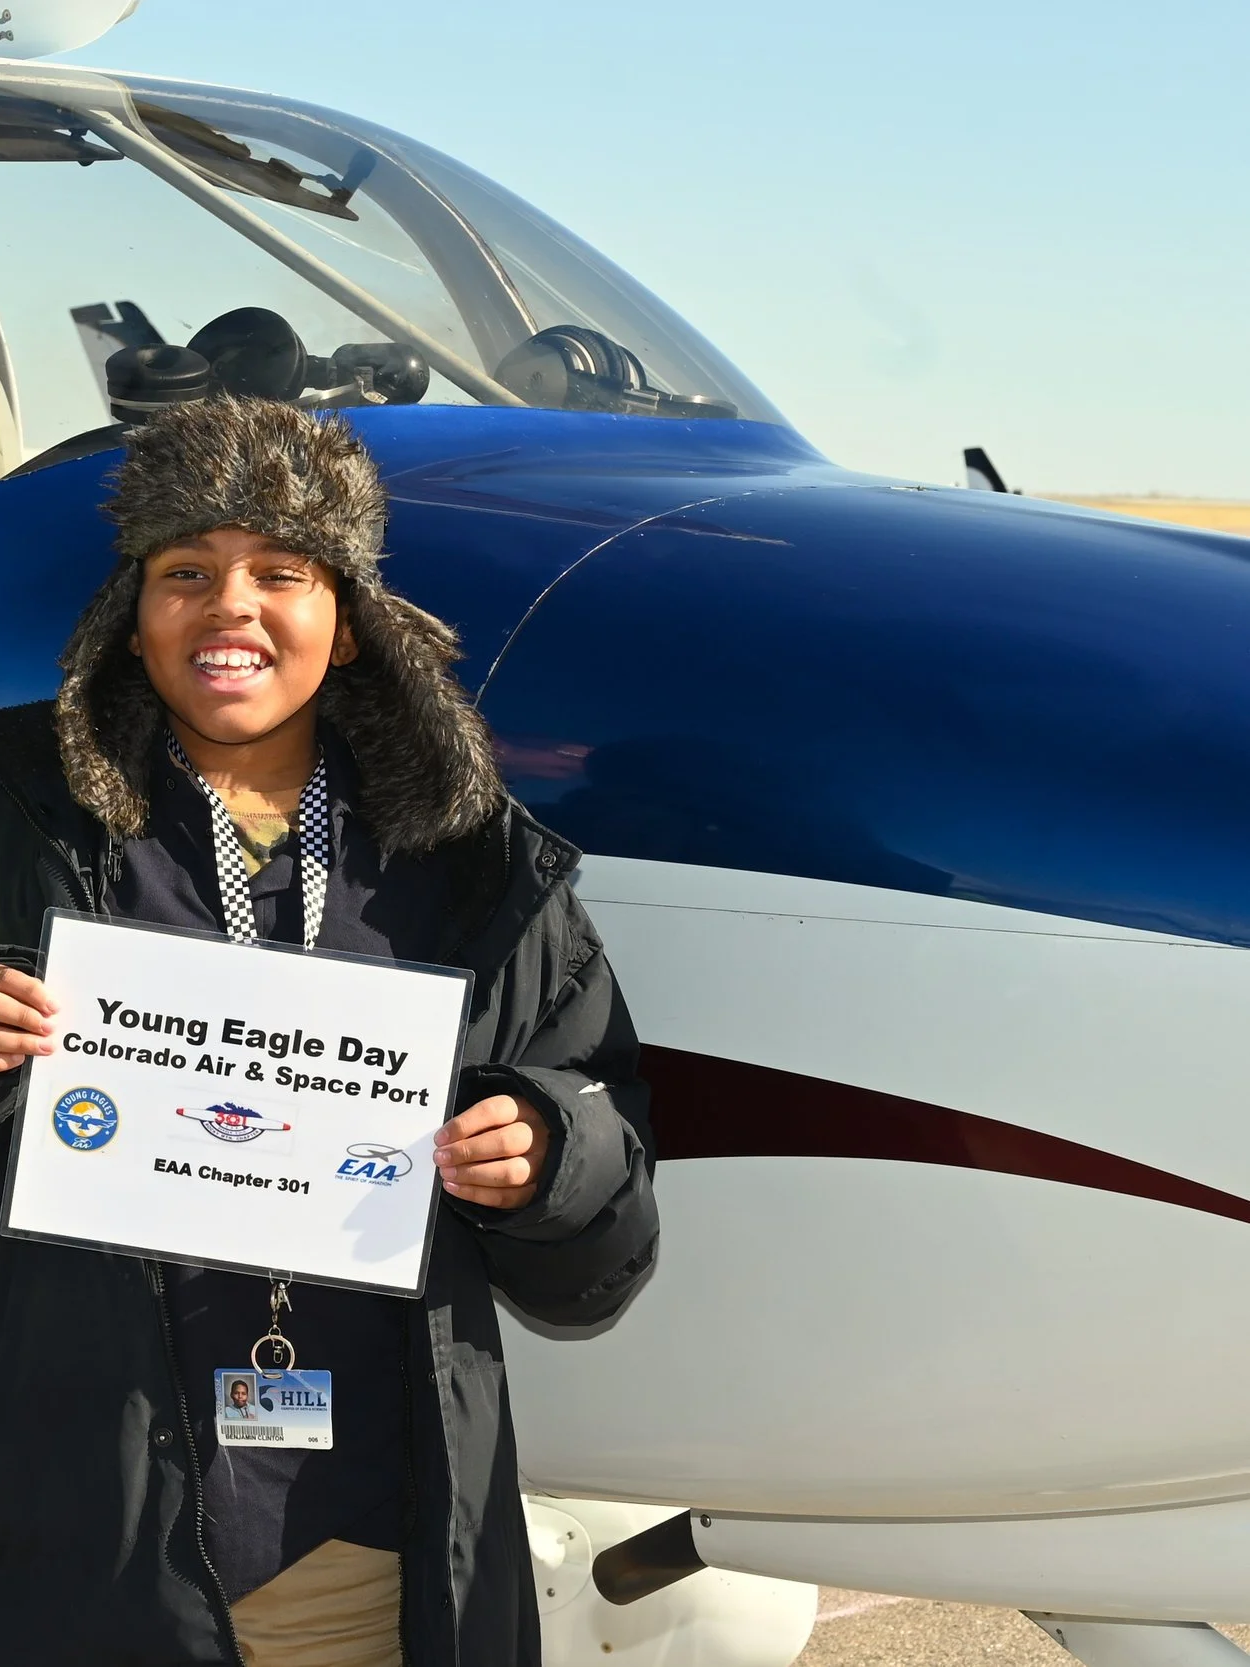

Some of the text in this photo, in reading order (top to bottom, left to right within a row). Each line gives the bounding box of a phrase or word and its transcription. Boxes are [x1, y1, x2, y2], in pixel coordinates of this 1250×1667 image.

[97, 998, 409, 1076] Young Eagle Day
[63, 1032, 430, 1107] Colorado Air & Space Port
[60, 1090, 114, 1116] YOUNG EAGLES
[214, 1112, 246, 1127] 301
[154, 1158, 310, 1195] EAA Chapter 301
[336, 1158, 397, 1181] EAA
[280, 1390, 327, 1407] HILL
[226, 1433, 284, 1442] BENJAMIN CLINTON
